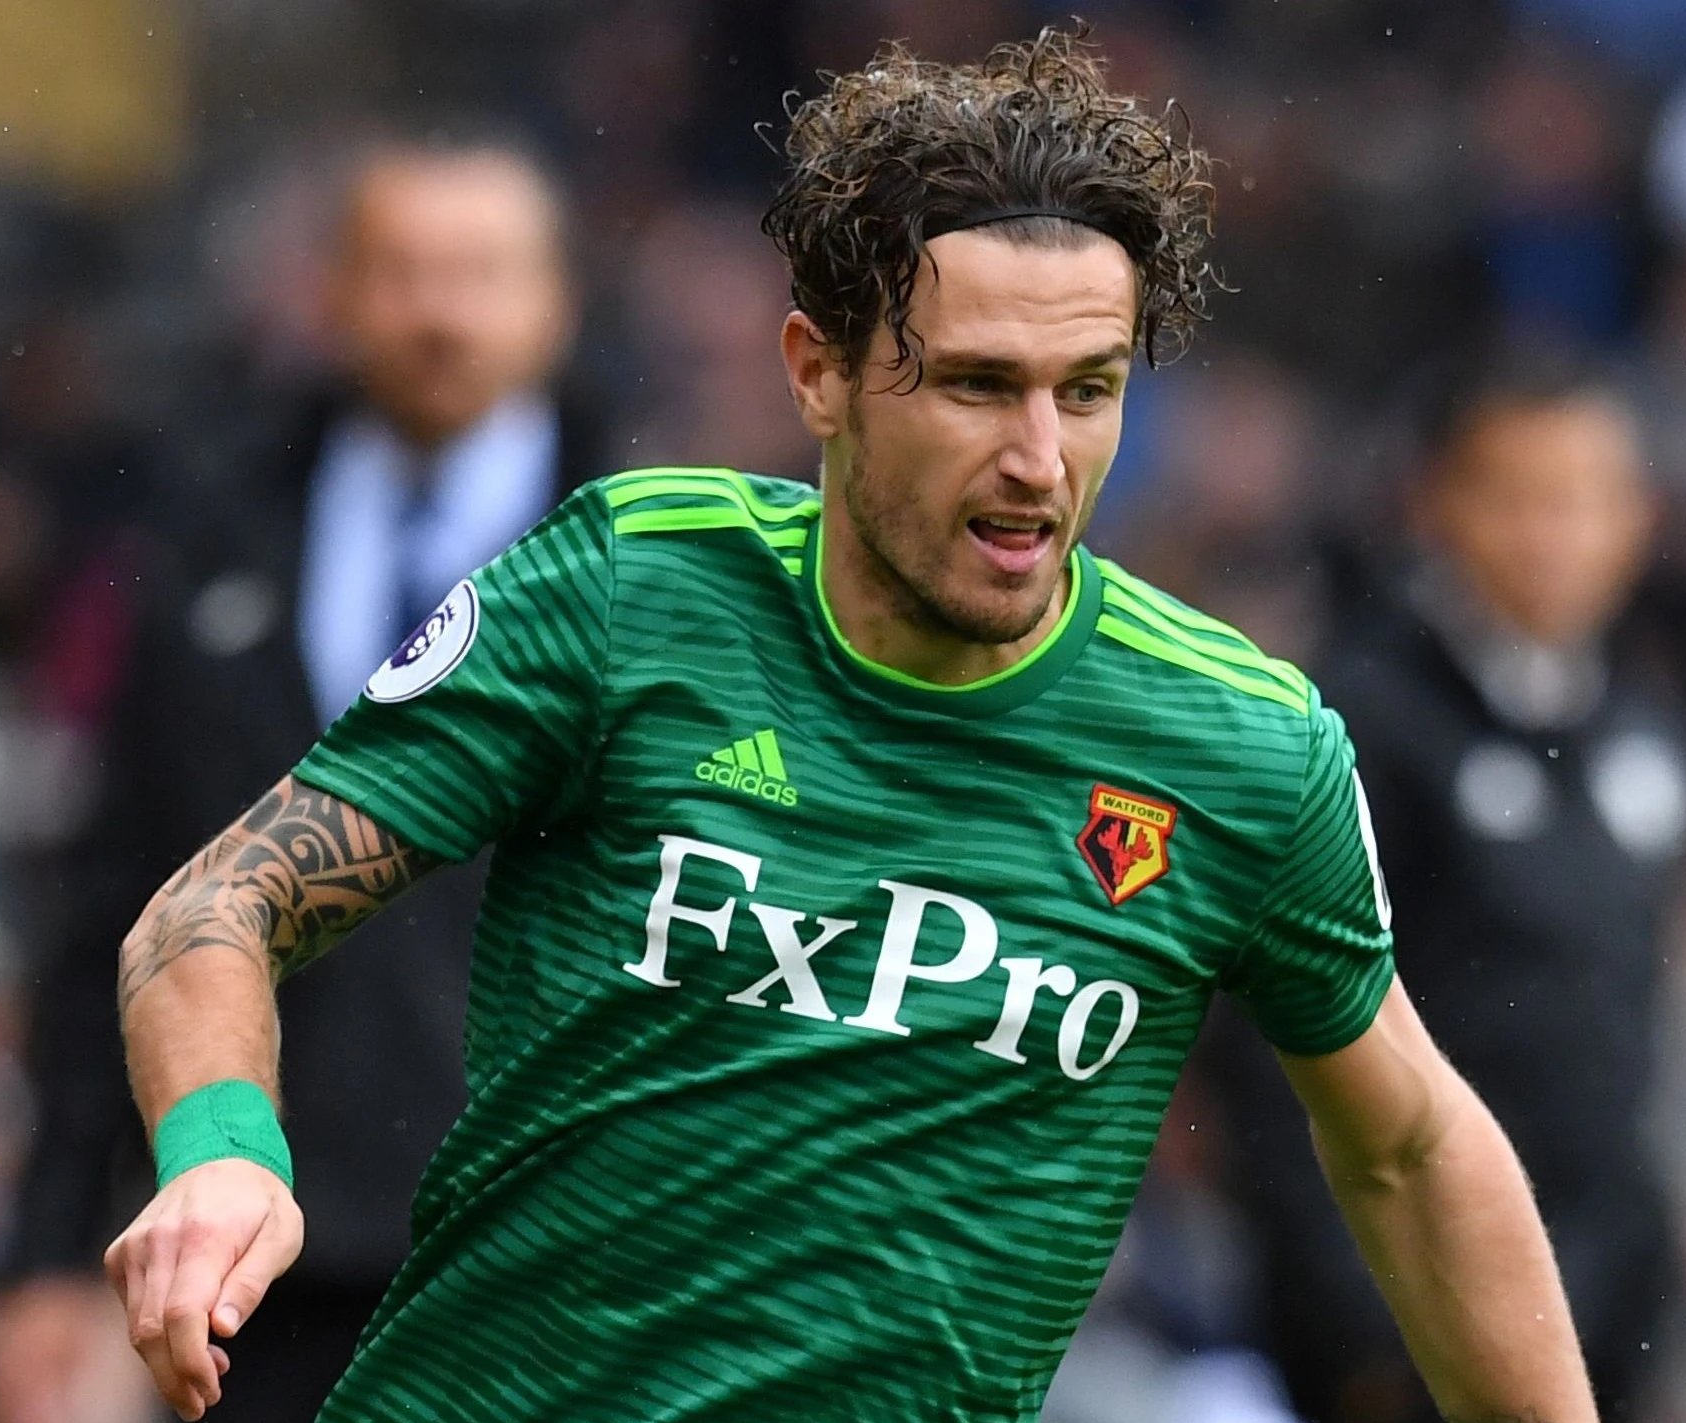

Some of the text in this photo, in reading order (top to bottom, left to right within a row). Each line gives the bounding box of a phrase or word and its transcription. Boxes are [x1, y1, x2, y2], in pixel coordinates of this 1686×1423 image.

[695, 761, 798, 807] adidas
[1102, 794, 1165, 822] WATFORD
[622, 834, 1139, 1081] FxPro
